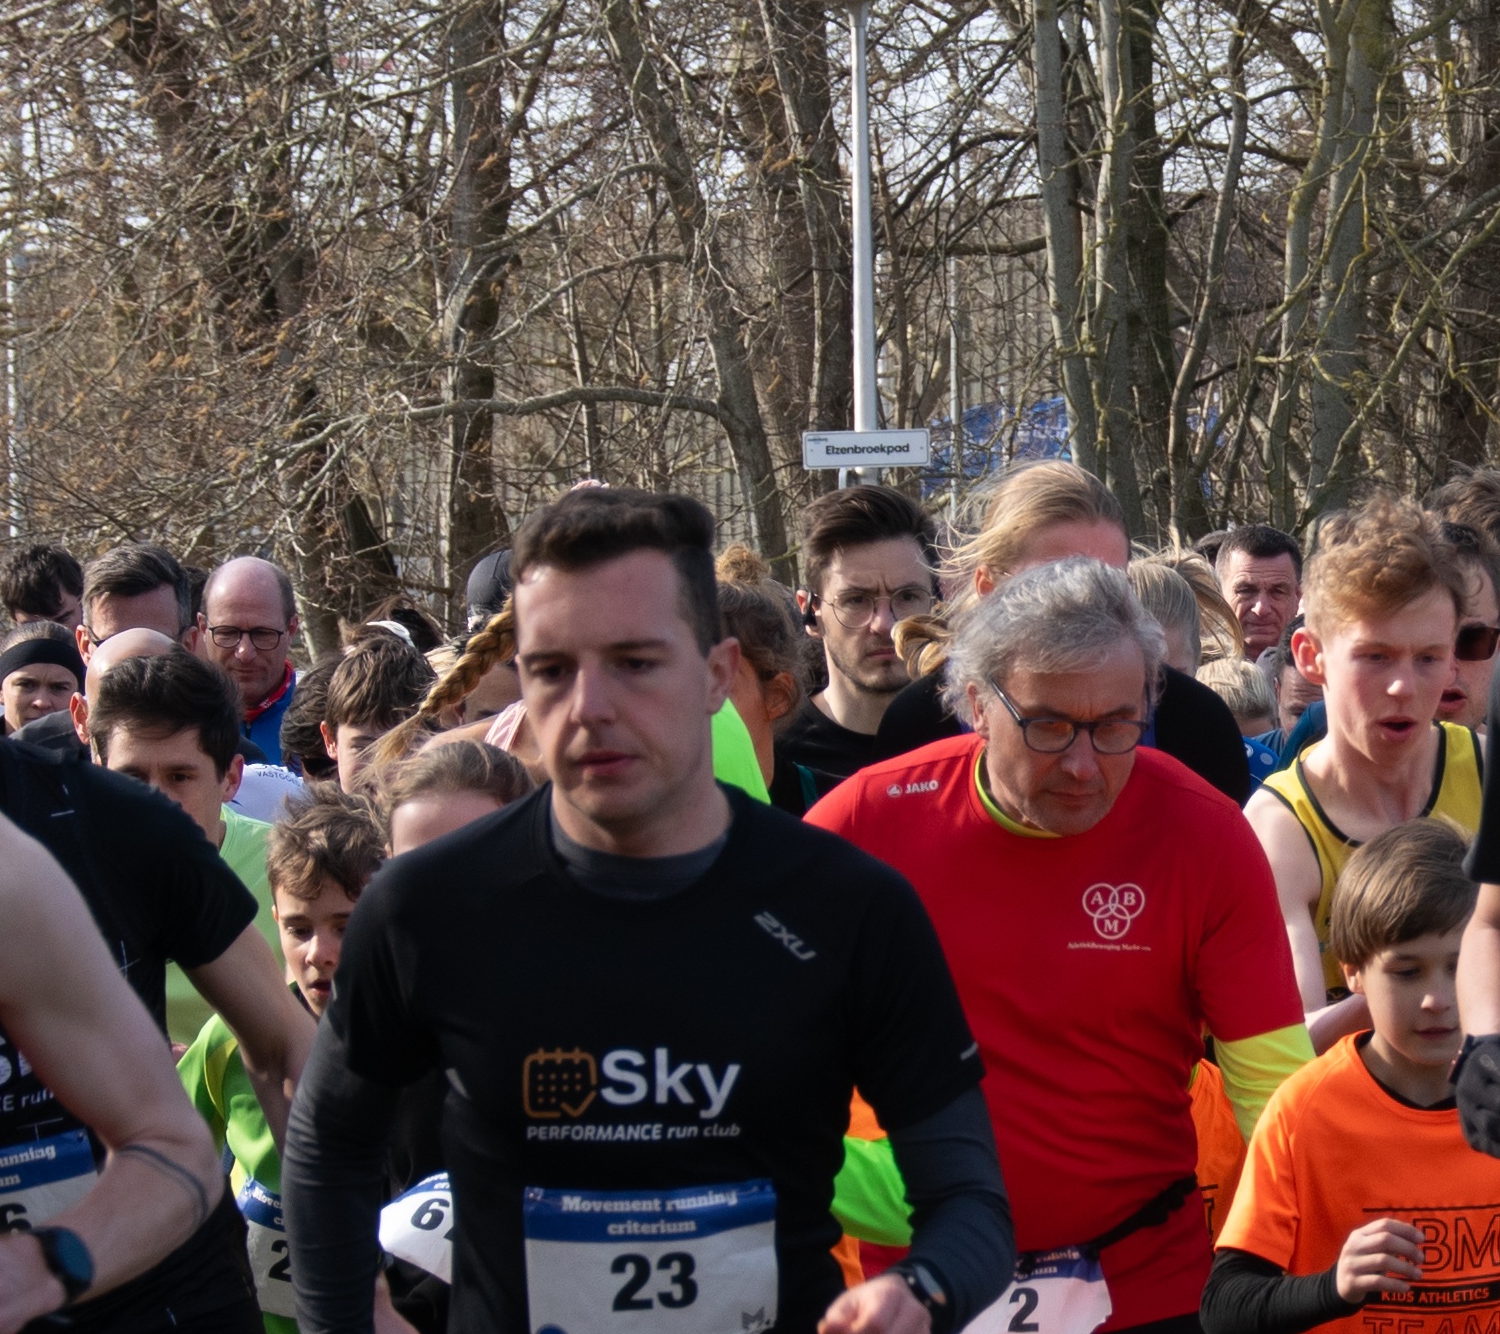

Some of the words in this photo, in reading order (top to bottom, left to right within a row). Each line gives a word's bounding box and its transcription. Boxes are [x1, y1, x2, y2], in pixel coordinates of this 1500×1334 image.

[825, 443, 910, 455] Elzenbroekpad
[906, 779, 939, 794] JAKO
[754, 911, 816, 960] 2XU
[601, 1047, 741, 1119] Sky
[527, 1123, 663, 1141] PERFORMANCE
[667, 1124, 698, 1139] run
[703, 1123, 741, 1137] club
[562, 1195, 662, 1213] Movement
[665, 1190, 738, 1211] running
[411, 1198, 453, 1242] 6
[607, 1219, 697, 1235] criterium
[610, 1251, 699, 1312] 23
[1381, 1289, 1415, 1303] KIDS
[1418, 1287, 1490, 1304] ATHLETICS
[1008, 1287, 1040, 1333] 2
